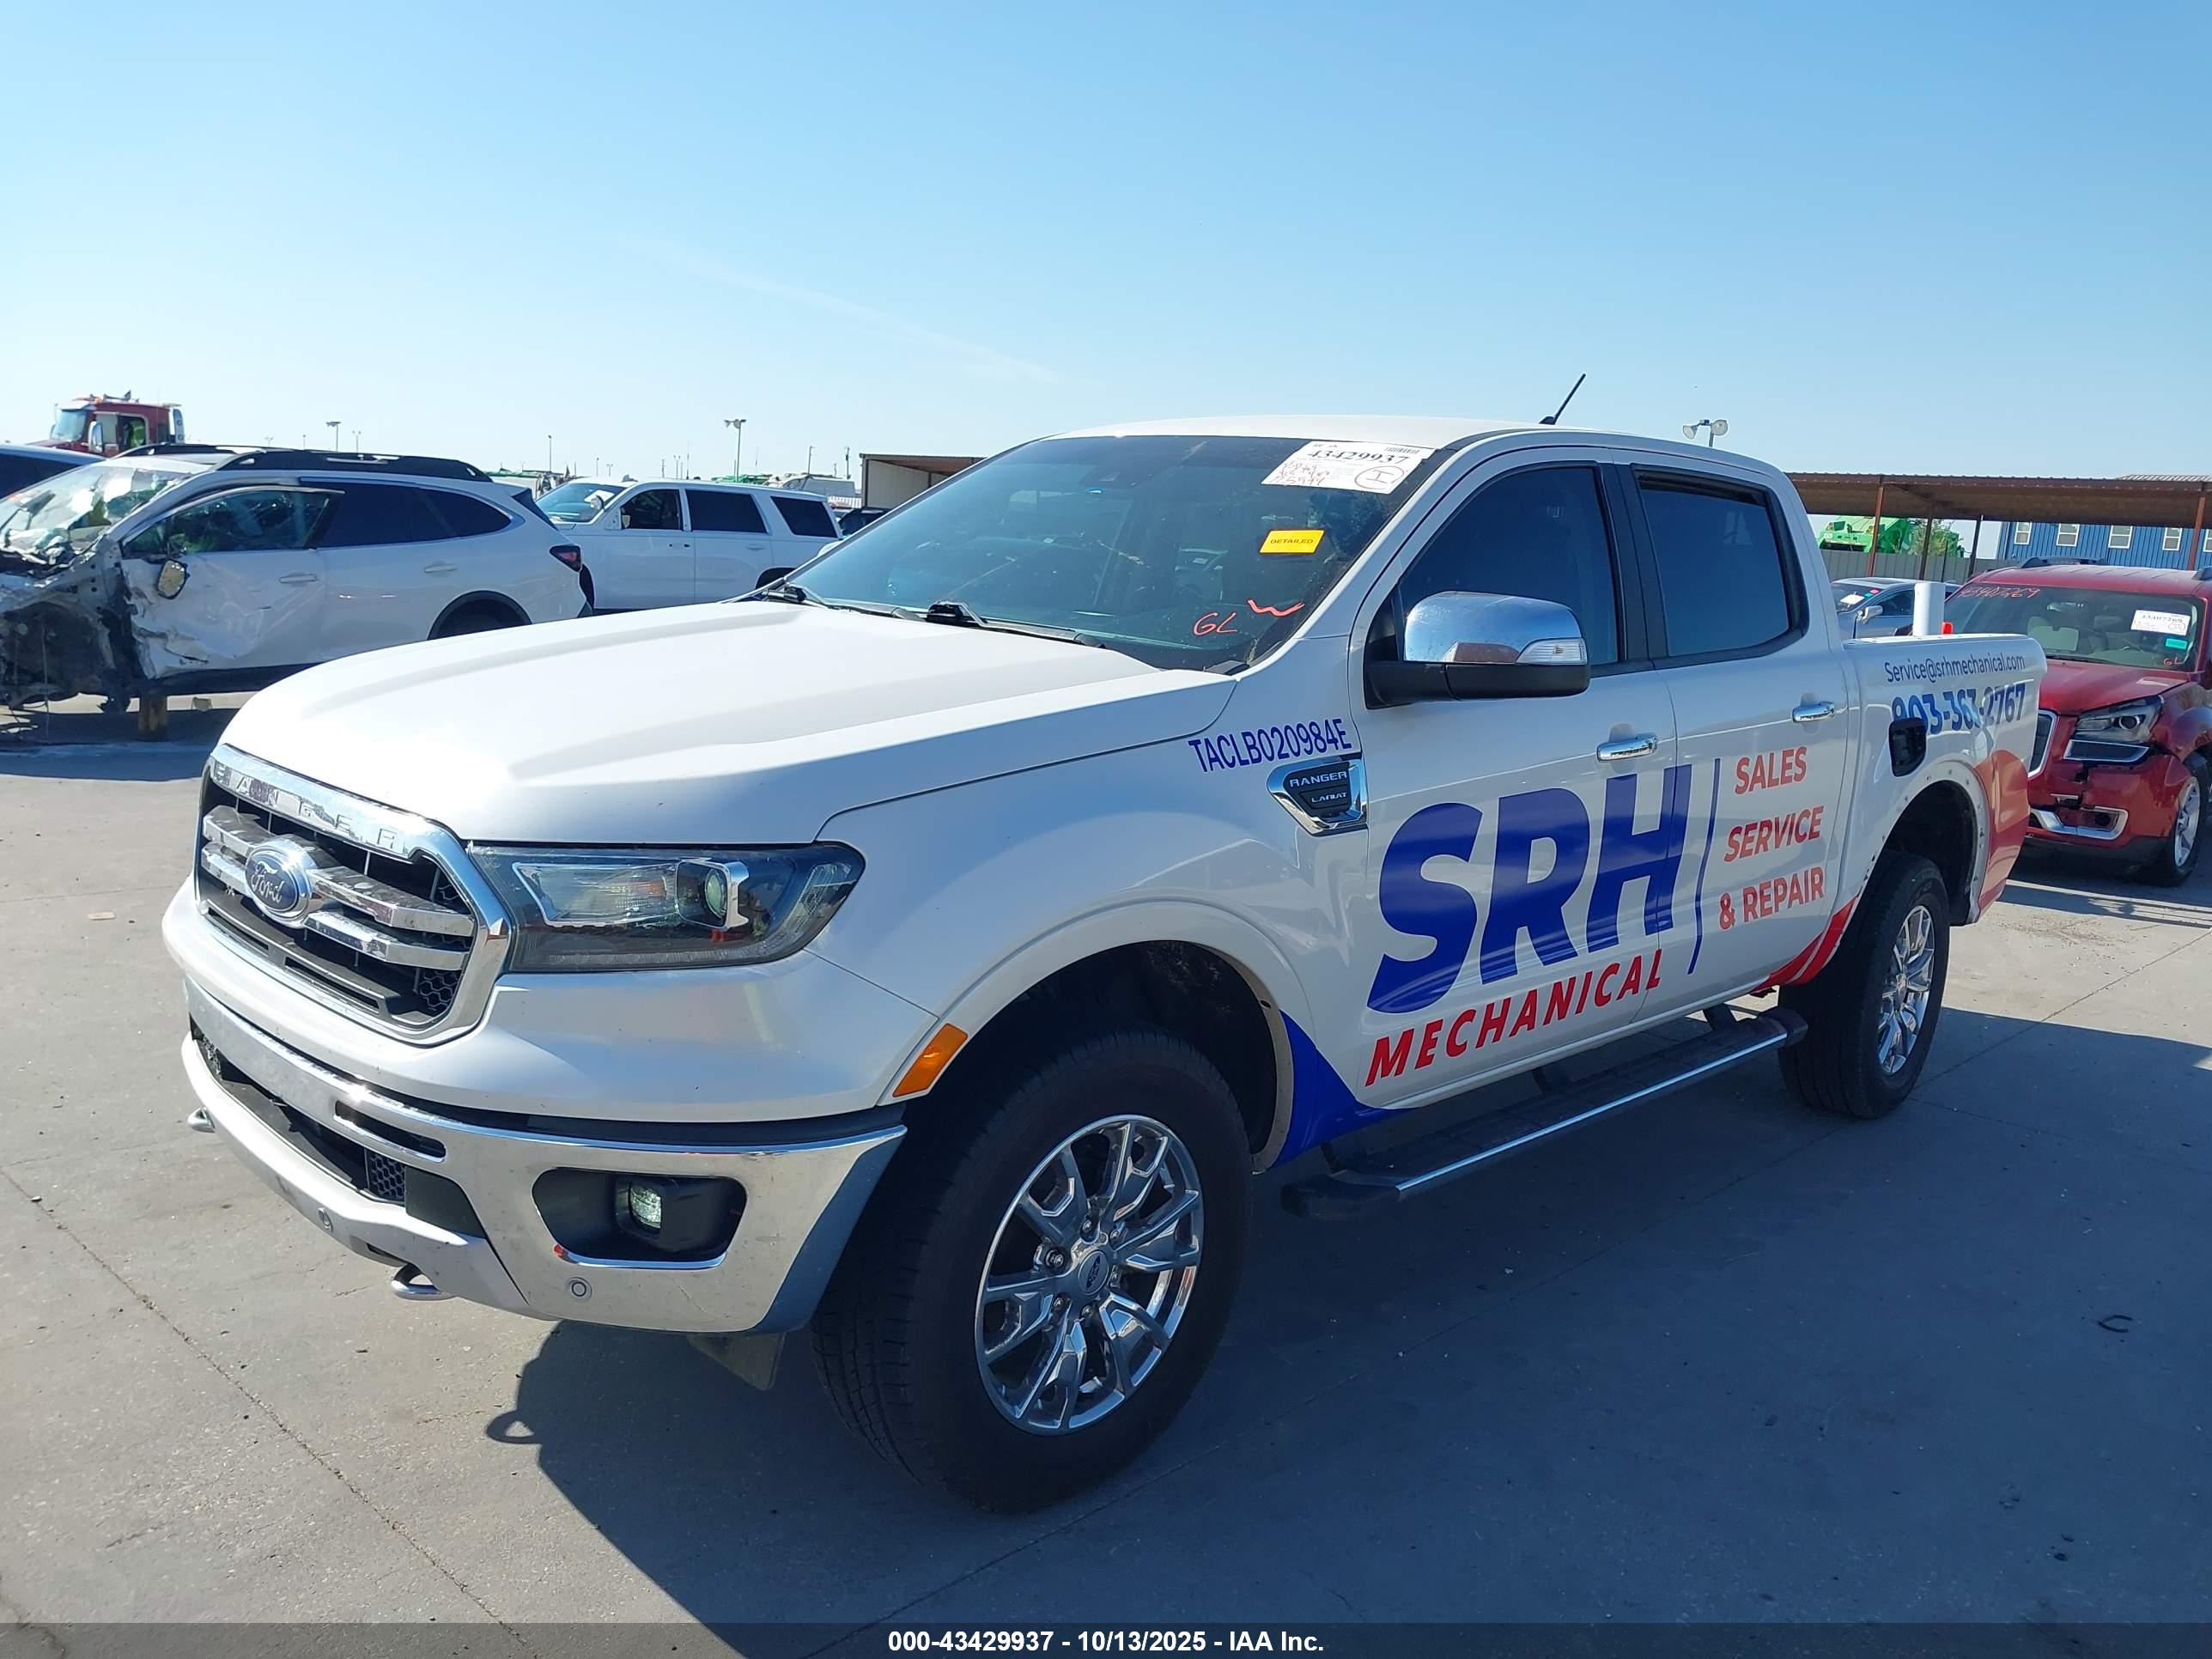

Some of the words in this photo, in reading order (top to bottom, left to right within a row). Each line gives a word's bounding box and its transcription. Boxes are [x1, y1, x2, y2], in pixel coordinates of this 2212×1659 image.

[1307, 449, 1410, 465] 43429937
[1884, 653, 2026, 683] Service@srhmechanical.com
[1188, 718, 1352, 772] TACLB020984E
[1290, 770, 1347, 787] RANGER
[1735, 746, 1808, 795] SALES
[1311, 792, 1347, 803] LARIAT
[1723, 805, 1824, 862] SERVICE
[250, 861, 285, 903] Ford
[1367, 763, 1692, 1014] SRH
[1719, 895, 1736, 931] &
[1742, 866, 1825, 922] REPAIR
[1364, 949, 1663, 1087] MECHANICAL
